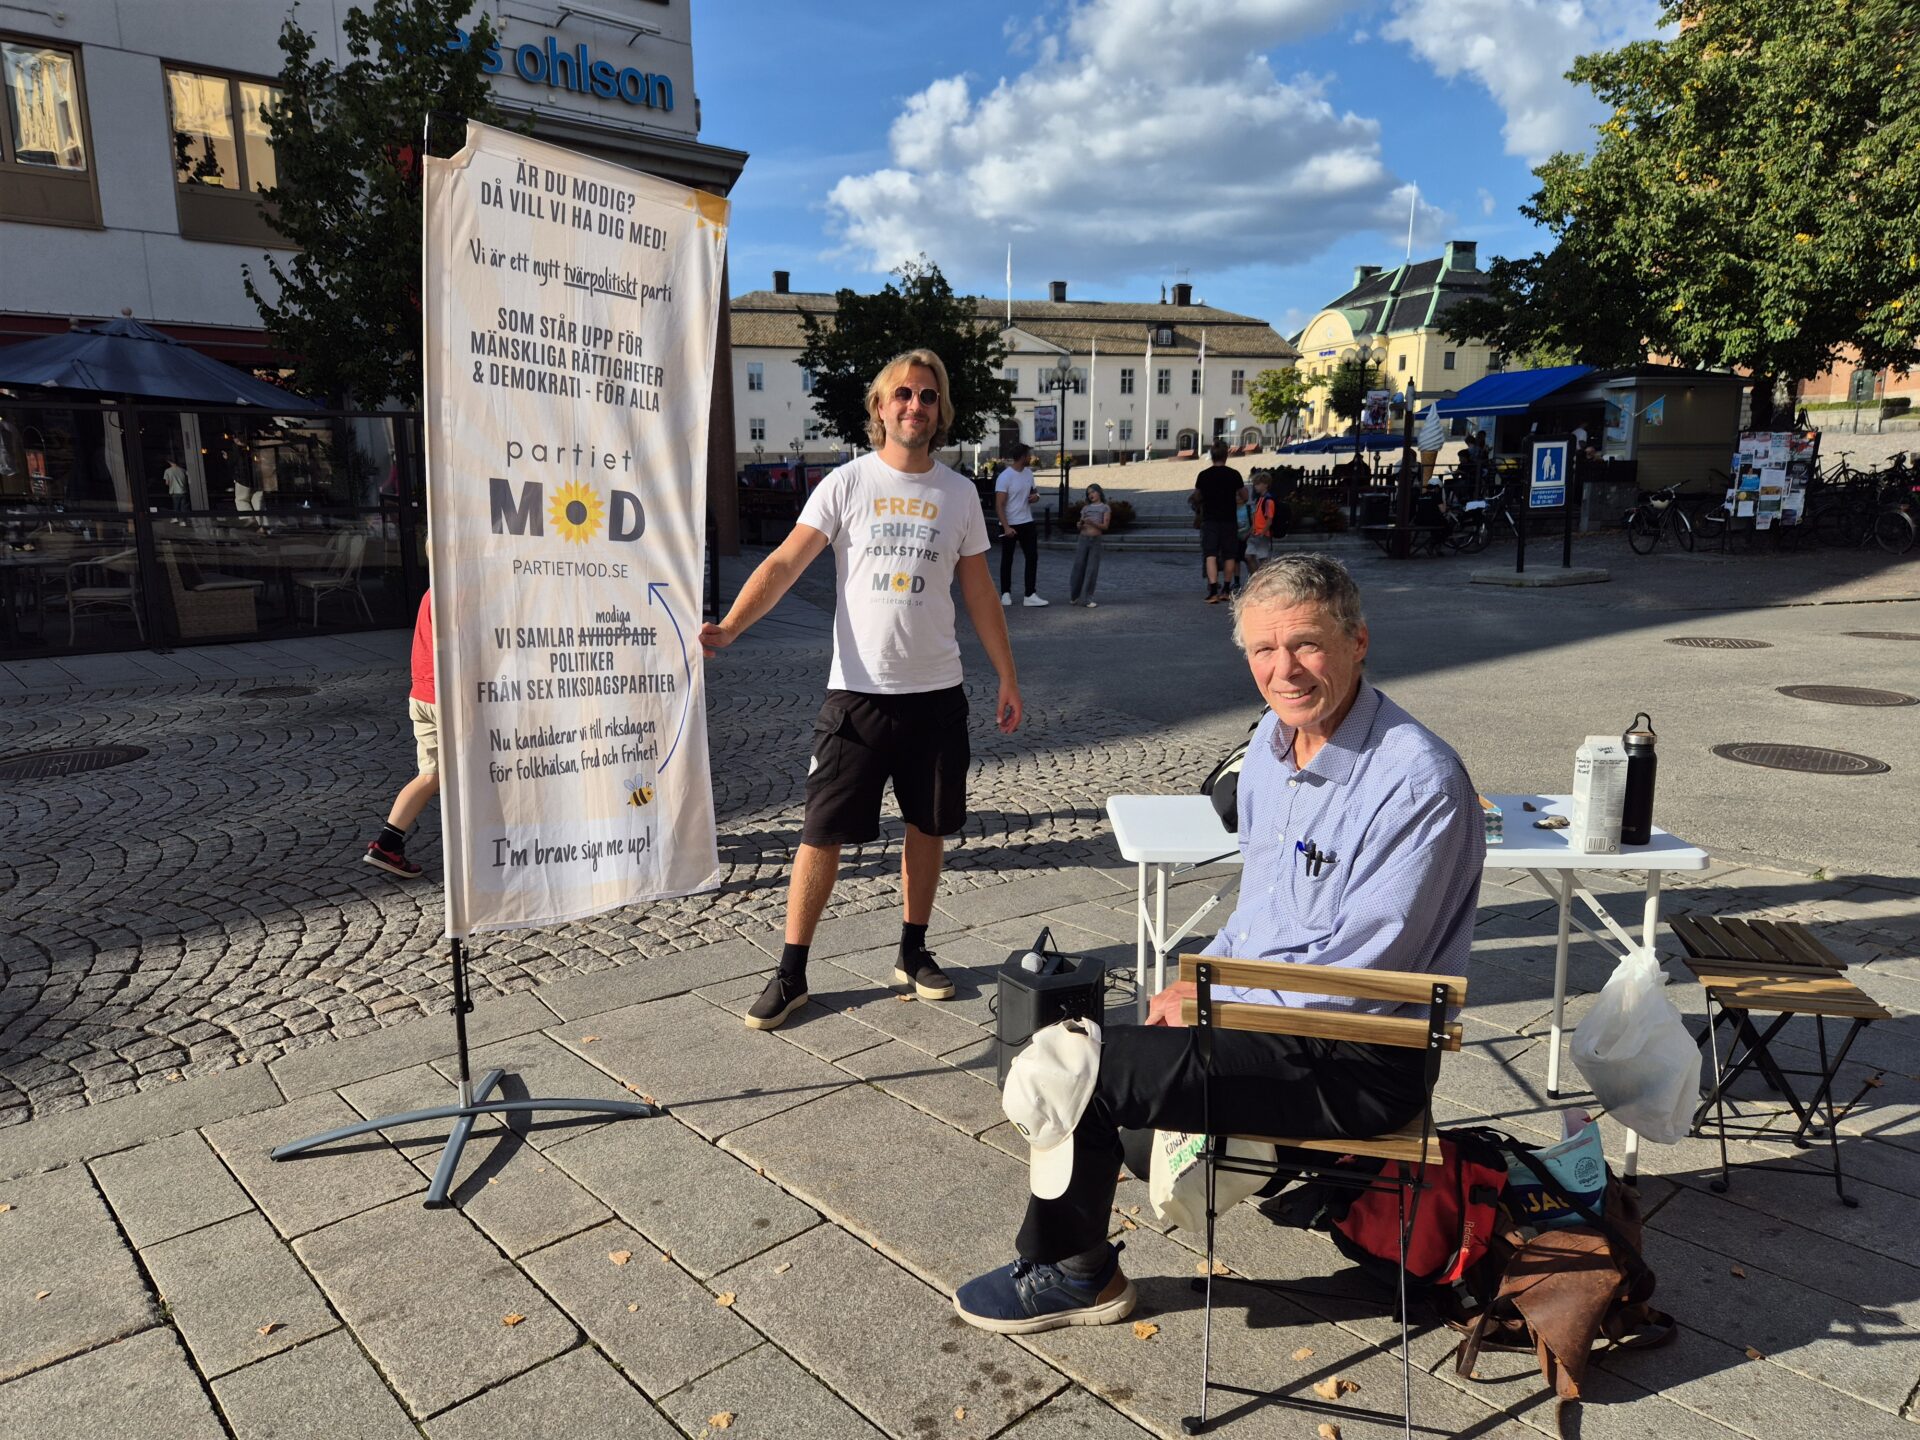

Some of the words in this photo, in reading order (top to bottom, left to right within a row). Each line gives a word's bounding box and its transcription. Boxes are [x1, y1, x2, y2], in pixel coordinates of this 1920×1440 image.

[516, 35, 674, 112] ohlson
[516, 157, 539, 189] ÄR
[545, 170, 566, 196] DU
[572, 177, 636, 215] MODIG?
[481, 178, 503, 209] DÅ
[510, 188, 545, 220] VILL
[550, 199, 566, 225] VI
[572, 205, 592, 232] HA
[598, 213, 624, 240] DIG
[629, 222, 667, 252] MED!
[470, 238, 486, 266] Vi
[490, 247, 506, 268] är
[510, 251, 530, 273] ett
[533, 255, 561, 287] nytt
[564, 262, 638, 298] tvärpolitiskt
[641, 281, 672, 308] parti
[498, 307, 534, 335] SOM
[540, 313, 577, 344] STÅR
[582, 325, 613, 350] UPP
[617, 330, 643, 358] FÖR
[470, 330, 567, 370] MÄNSKLIGA
[571, 352, 664, 388] RÄTTIGHETER
[472, 361, 485, 384] &
[490, 362, 581, 399] DEMOKRATI
[596, 380, 625, 407] FÖR
[630, 389, 660, 413] ALLA
[506, 440, 632, 473] partiet
[489, 477, 646, 545] MOD
[873, 497, 938, 521] FRED
[870, 522, 941, 543] FRIHET
[512, 559, 629, 579] PARTIETMOD.SE
[866, 545, 940, 563] FOLKSTYRE
[595, 604, 631, 630] modiga
[494, 627, 511, 649] VI
[517, 627, 574, 649] SAMLAR
[550, 651, 614, 673] POLITIKER
[477, 675, 521, 703] FRÅN
[527, 678, 554, 700] SEX
[557, 673, 675, 699] RIKSDAGSPARTIER
[490, 729, 511, 752] Nu
[515, 725, 577, 750] kandiderar
[579, 725, 588, 739] vi
[589, 718, 603, 738] till
[605, 716, 656, 744] riksdagen
[489, 762, 512, 783] för
[517, 755, 579, 781] folkhälsan,
[581, 748, 600, 771] fred
[602, 744, 619, 765] och
[621, 743, 659, 764] frihet!
[492, 837, 528, 867] I'm
[535, 836, 578, 864] brave
[581, 840, 603, 872] sign
[606, 838, 624, 853] me
[628, 826, 651, 864] up!
